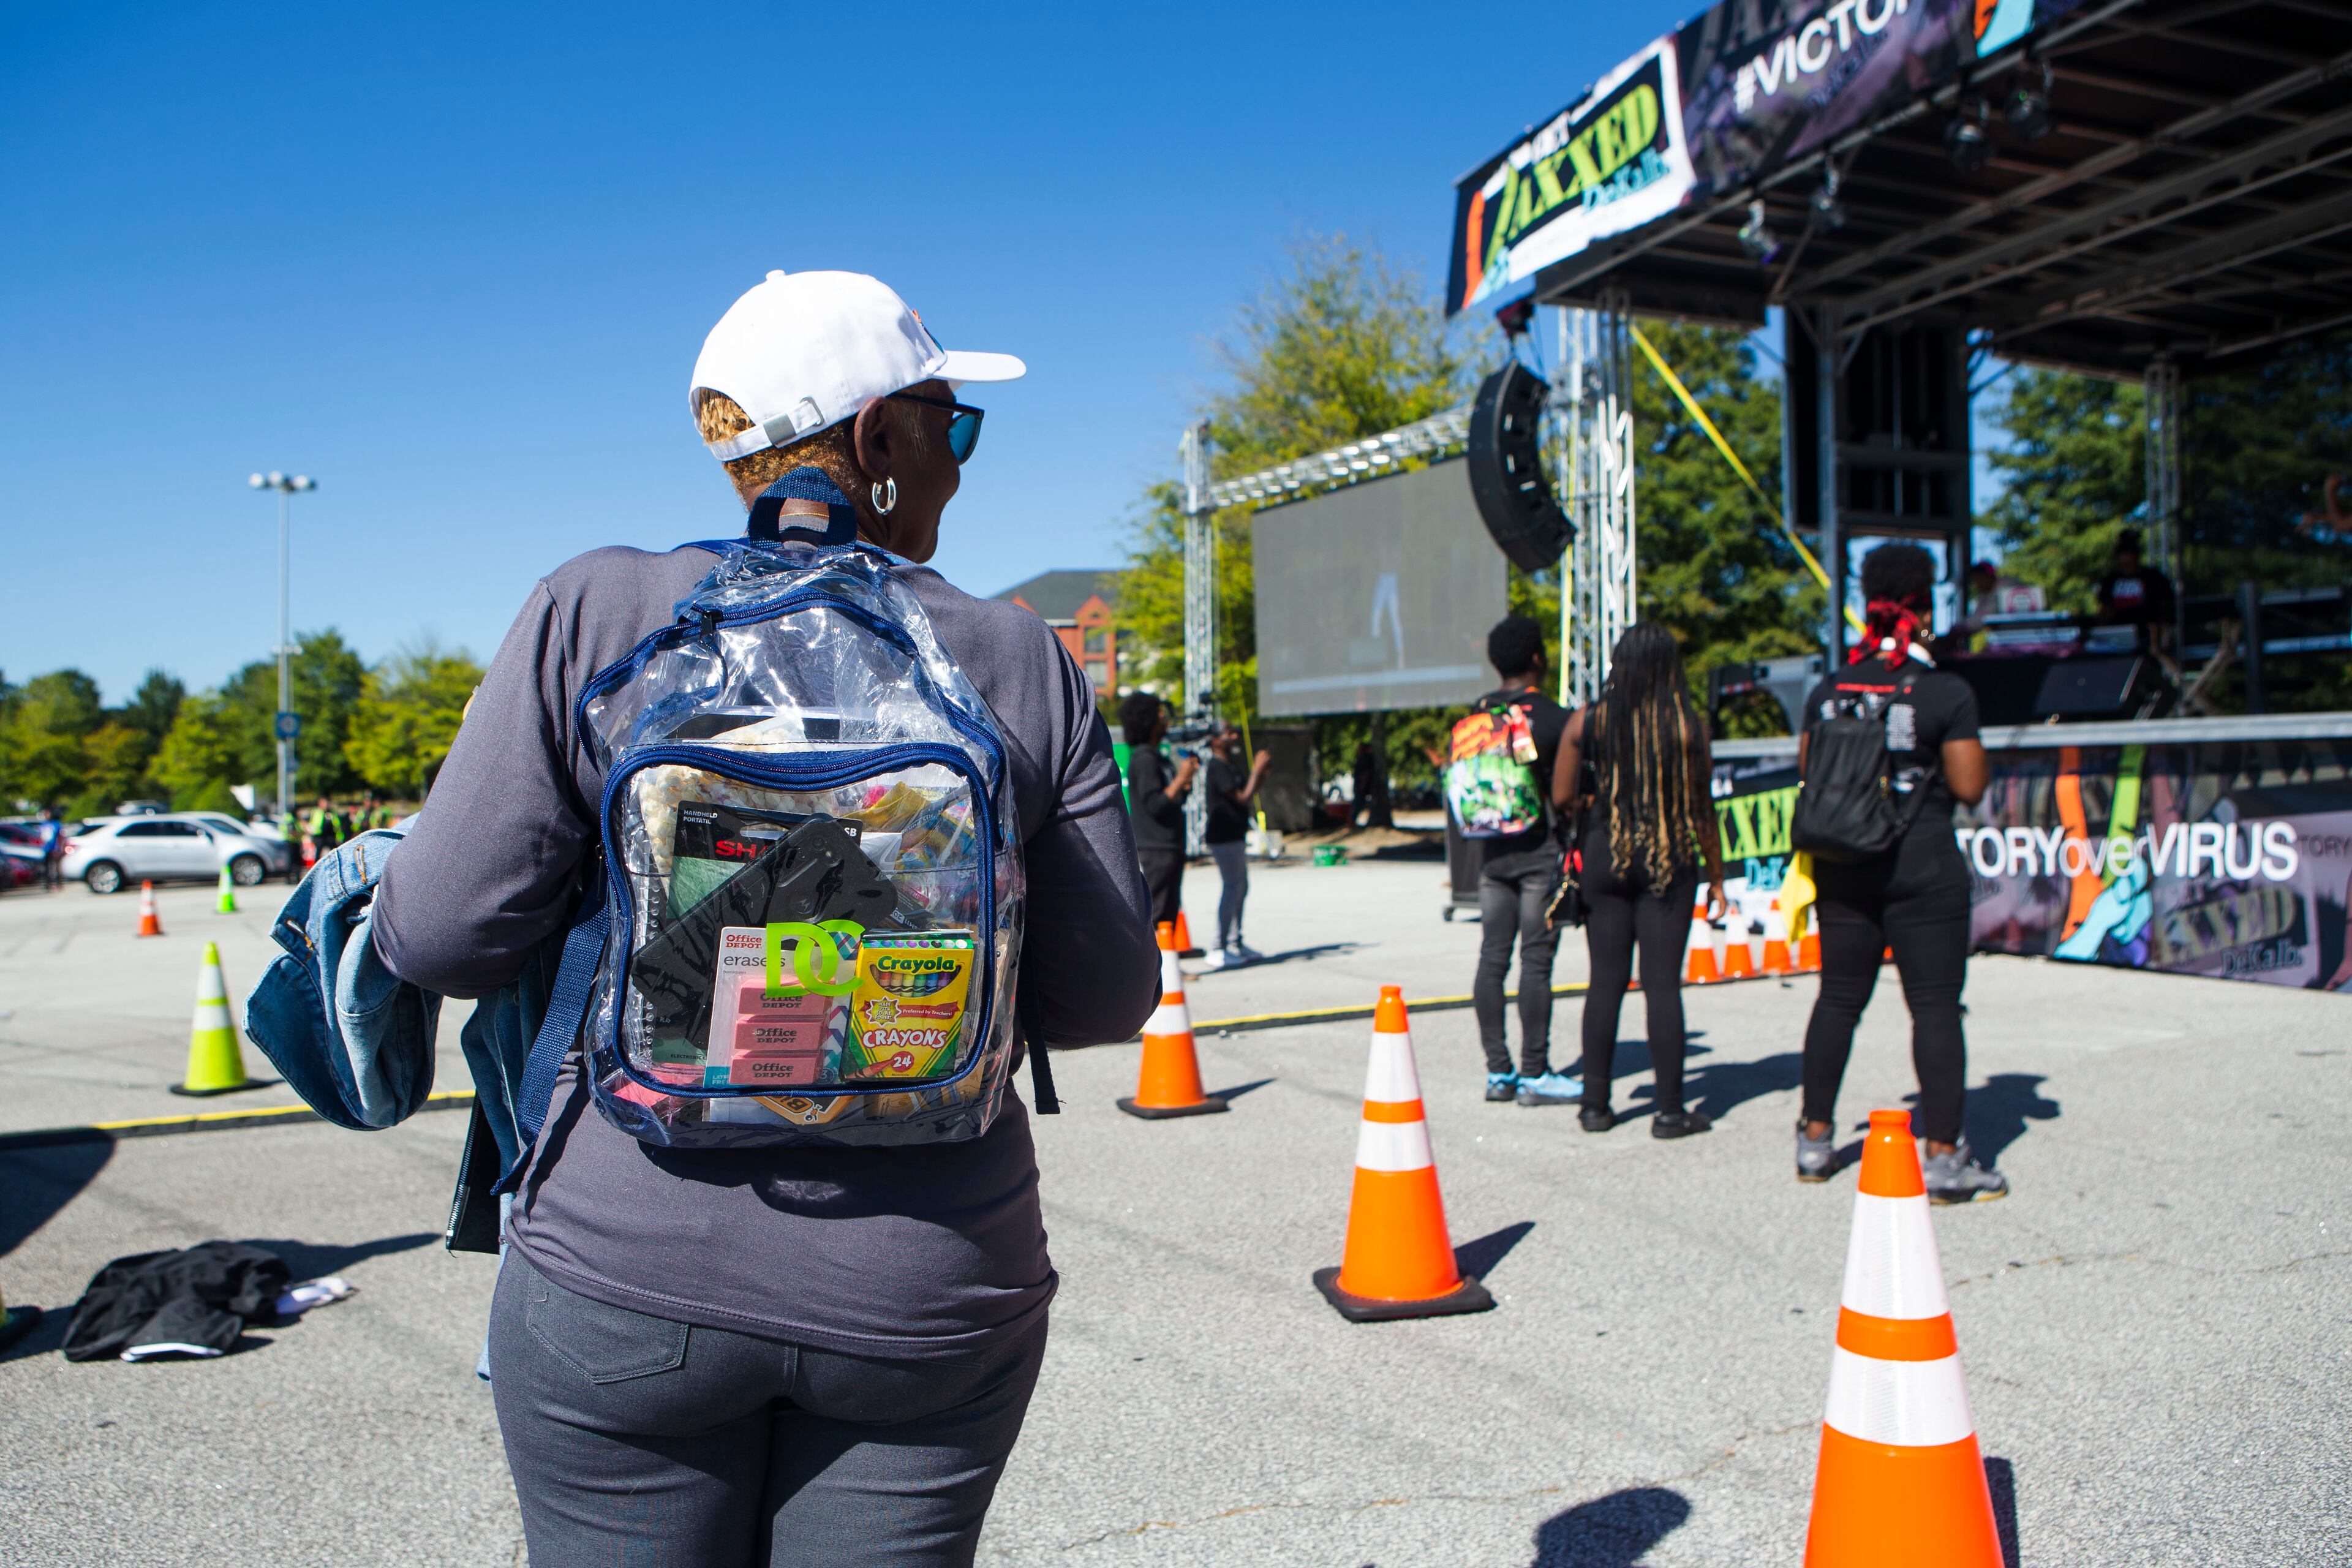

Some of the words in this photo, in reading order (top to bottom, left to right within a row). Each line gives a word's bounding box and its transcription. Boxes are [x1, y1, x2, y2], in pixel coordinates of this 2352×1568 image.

[1733, 0, 1908, 115] #VICTO
[684, 810, 718, 819] HANDHELD
[1744, 857, 1791, 891] DeK
[726, 934, 763, 943] Office
[723, 956, 786, 967] erases
[878, 956, 955, 974] Crayola
[755, 1028, 797, 1036] Office
[862, 1028, 948, 1048] CRAYONS
[752, 1063, 794, 1072] Office
[892, 1055, 912, 1068] 24
